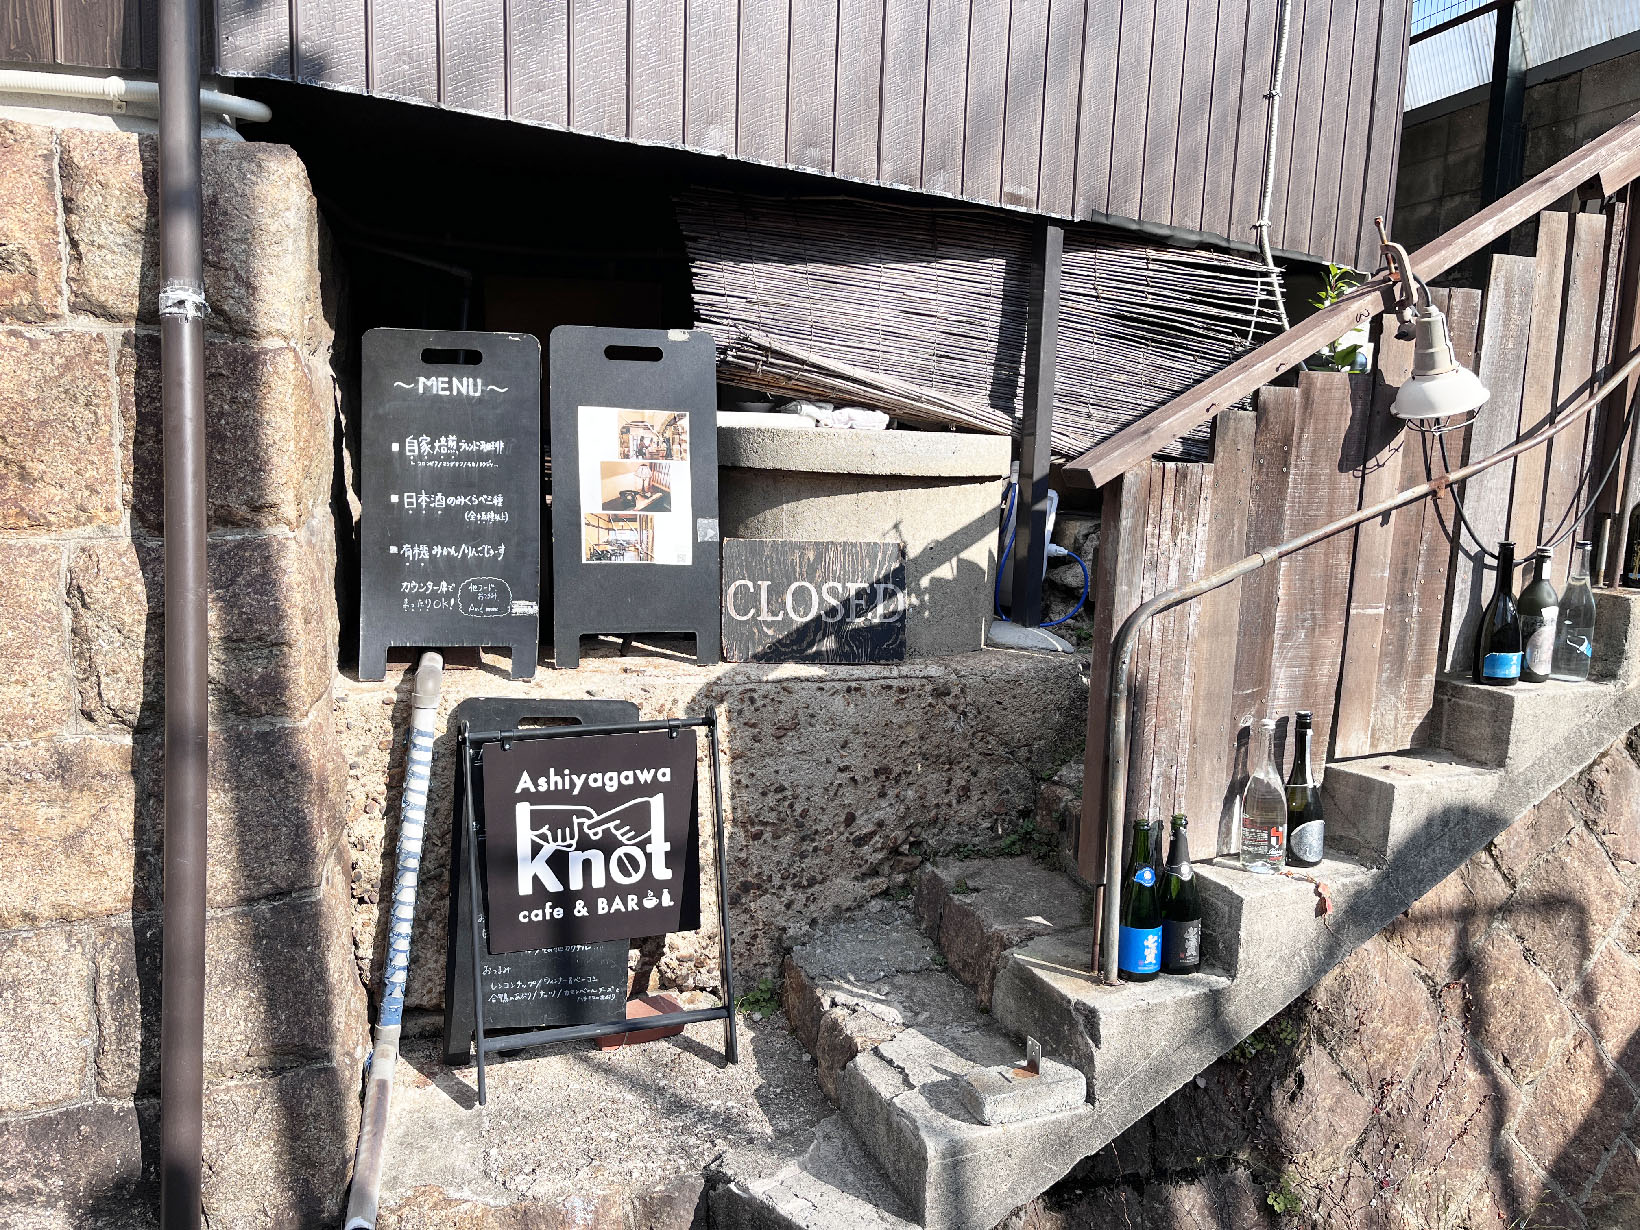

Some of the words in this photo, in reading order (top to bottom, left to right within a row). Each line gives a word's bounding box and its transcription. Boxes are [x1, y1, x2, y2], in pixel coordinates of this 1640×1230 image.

[726, 579, 906, 623] CLOSED
[515, 767, 671, 795] Ashiyagawa
[518, 902, 564, 922] cafe
[573, 899, 589, 917] &
[597, 894, 640, 915] BAR
